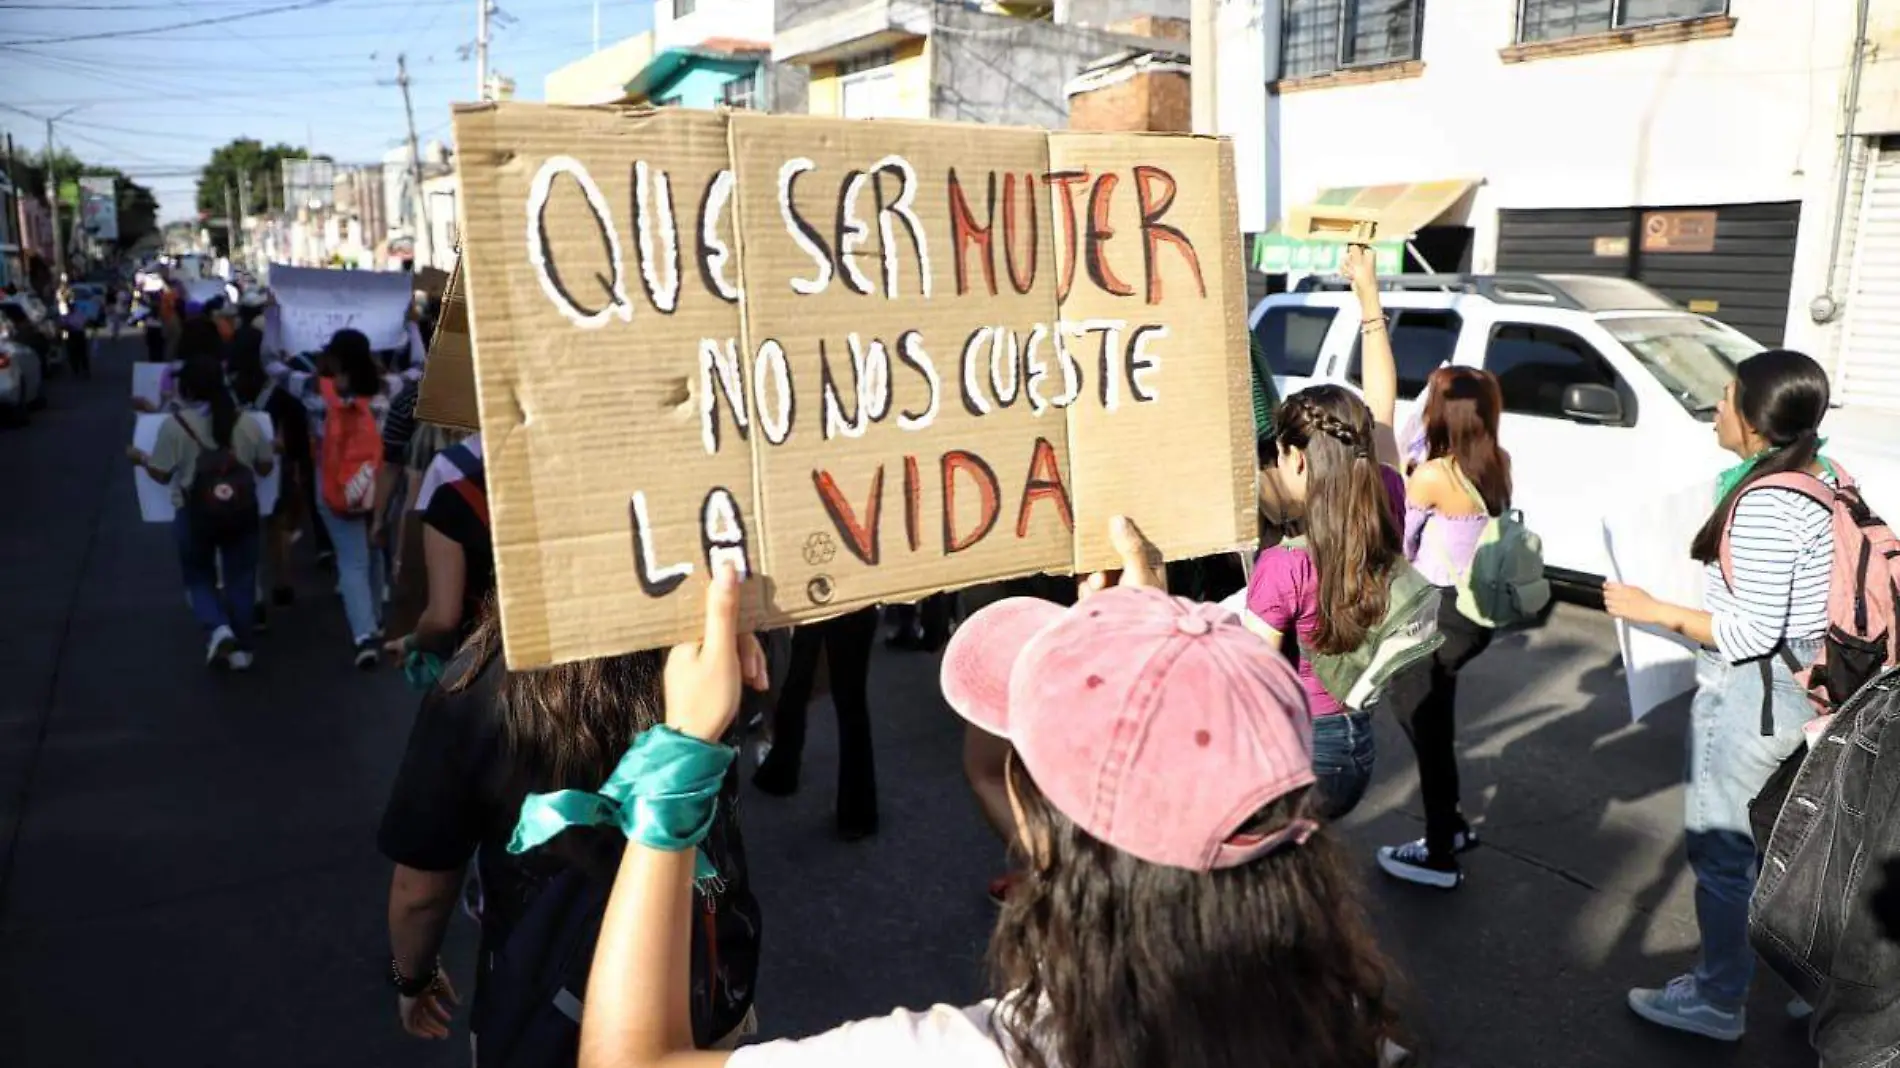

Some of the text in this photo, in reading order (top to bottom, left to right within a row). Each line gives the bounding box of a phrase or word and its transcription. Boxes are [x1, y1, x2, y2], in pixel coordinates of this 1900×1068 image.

[526, 154, 1207, 328] QUE SER MUJER
[699, 319, 1168, 456] NO NOS CUESTE
[630, 436, 1075, 598] LA VIDA
